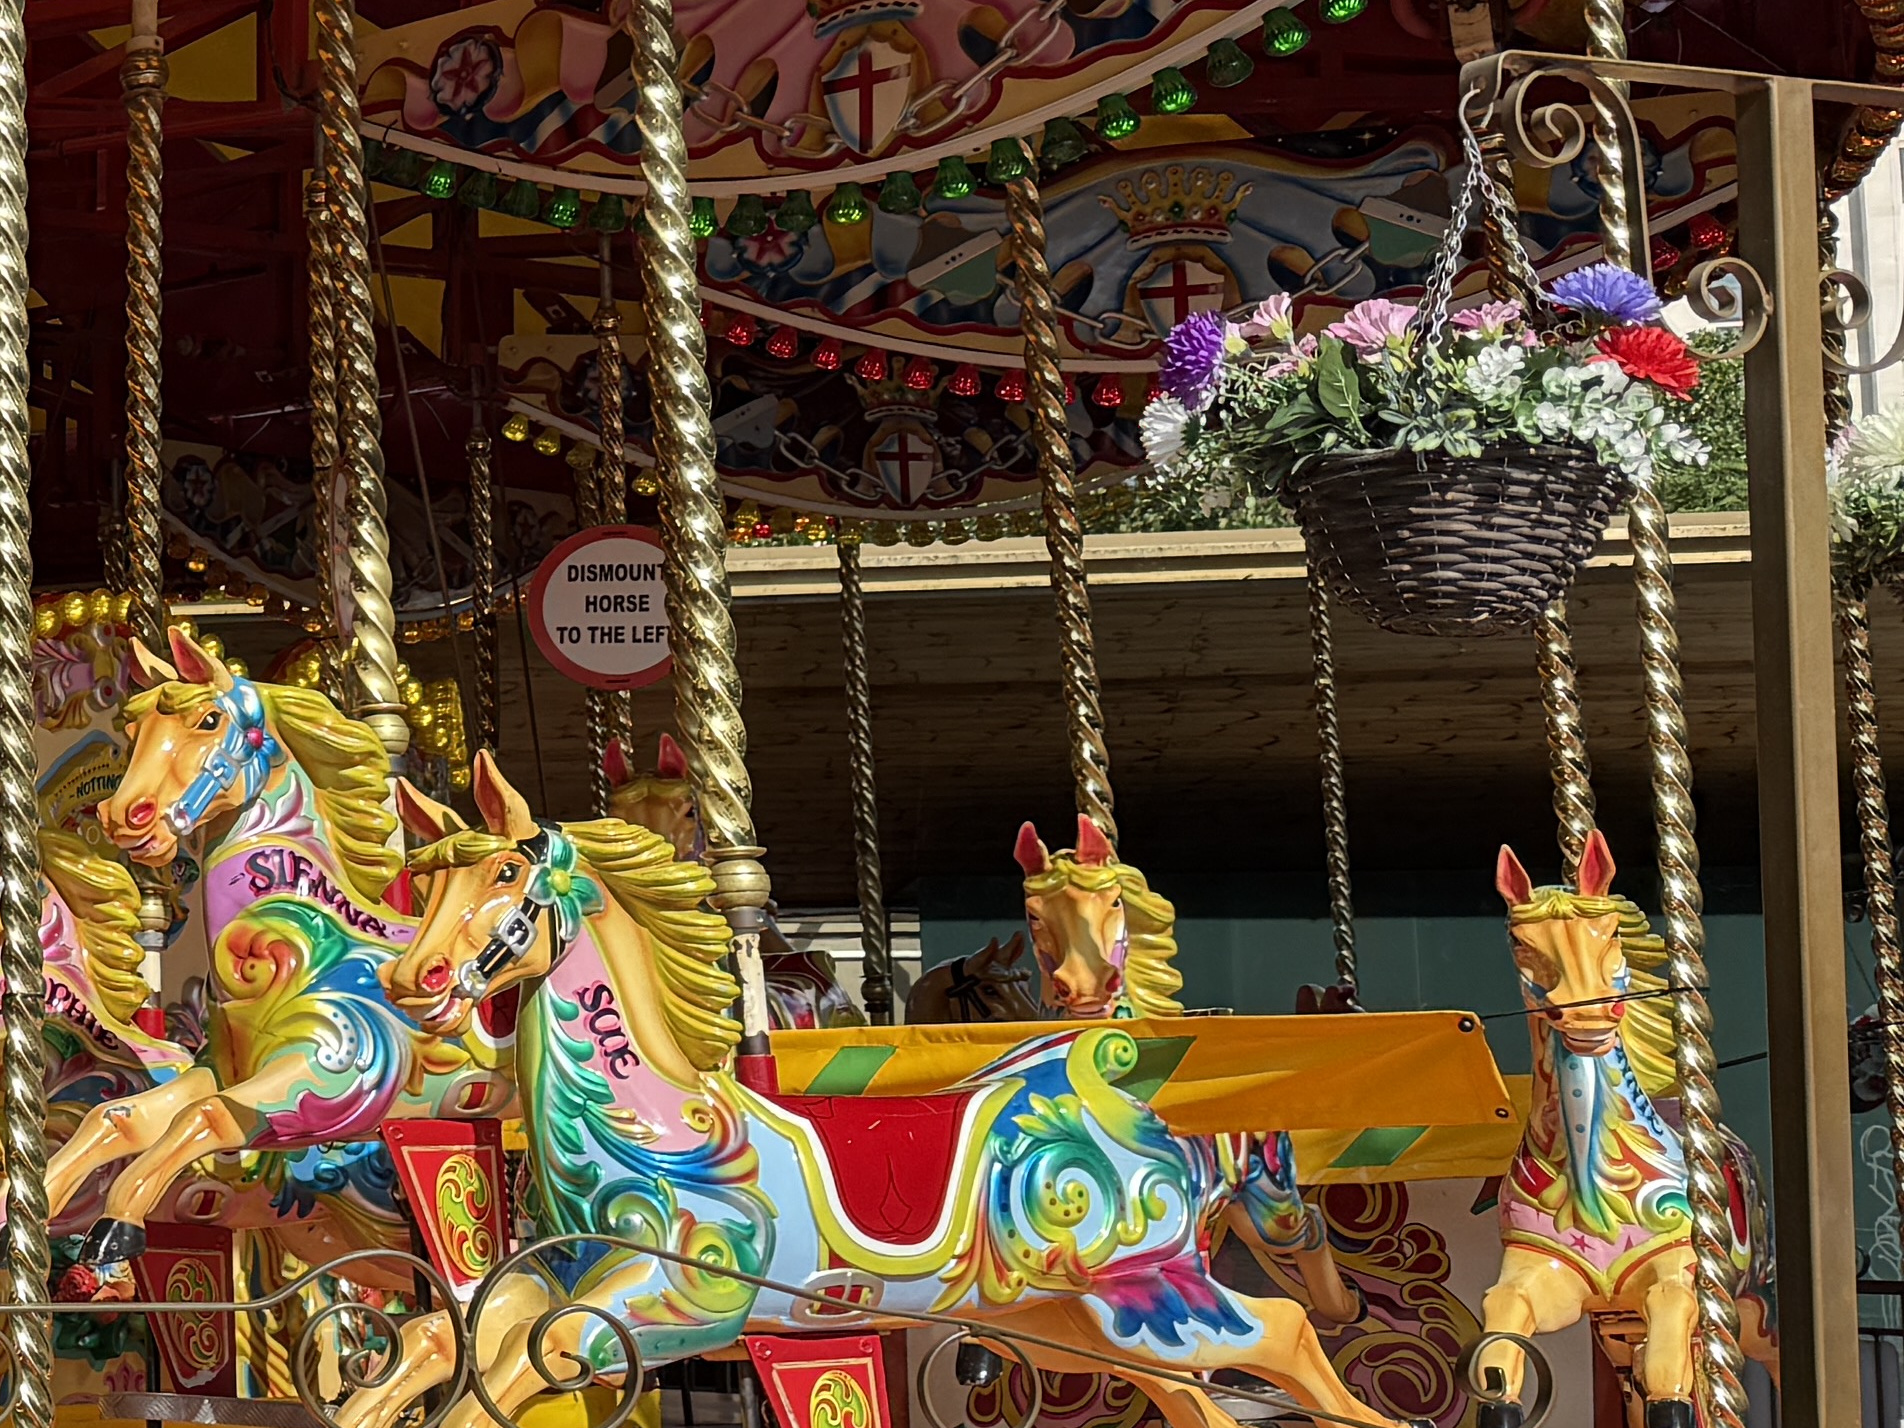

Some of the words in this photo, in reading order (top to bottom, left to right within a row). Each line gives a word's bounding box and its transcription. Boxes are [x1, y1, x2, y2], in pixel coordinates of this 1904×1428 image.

[584, 594, 651, 614] HORSE
[555, 626, 582, 645] TO
[587, 625, 626, 645] THE
